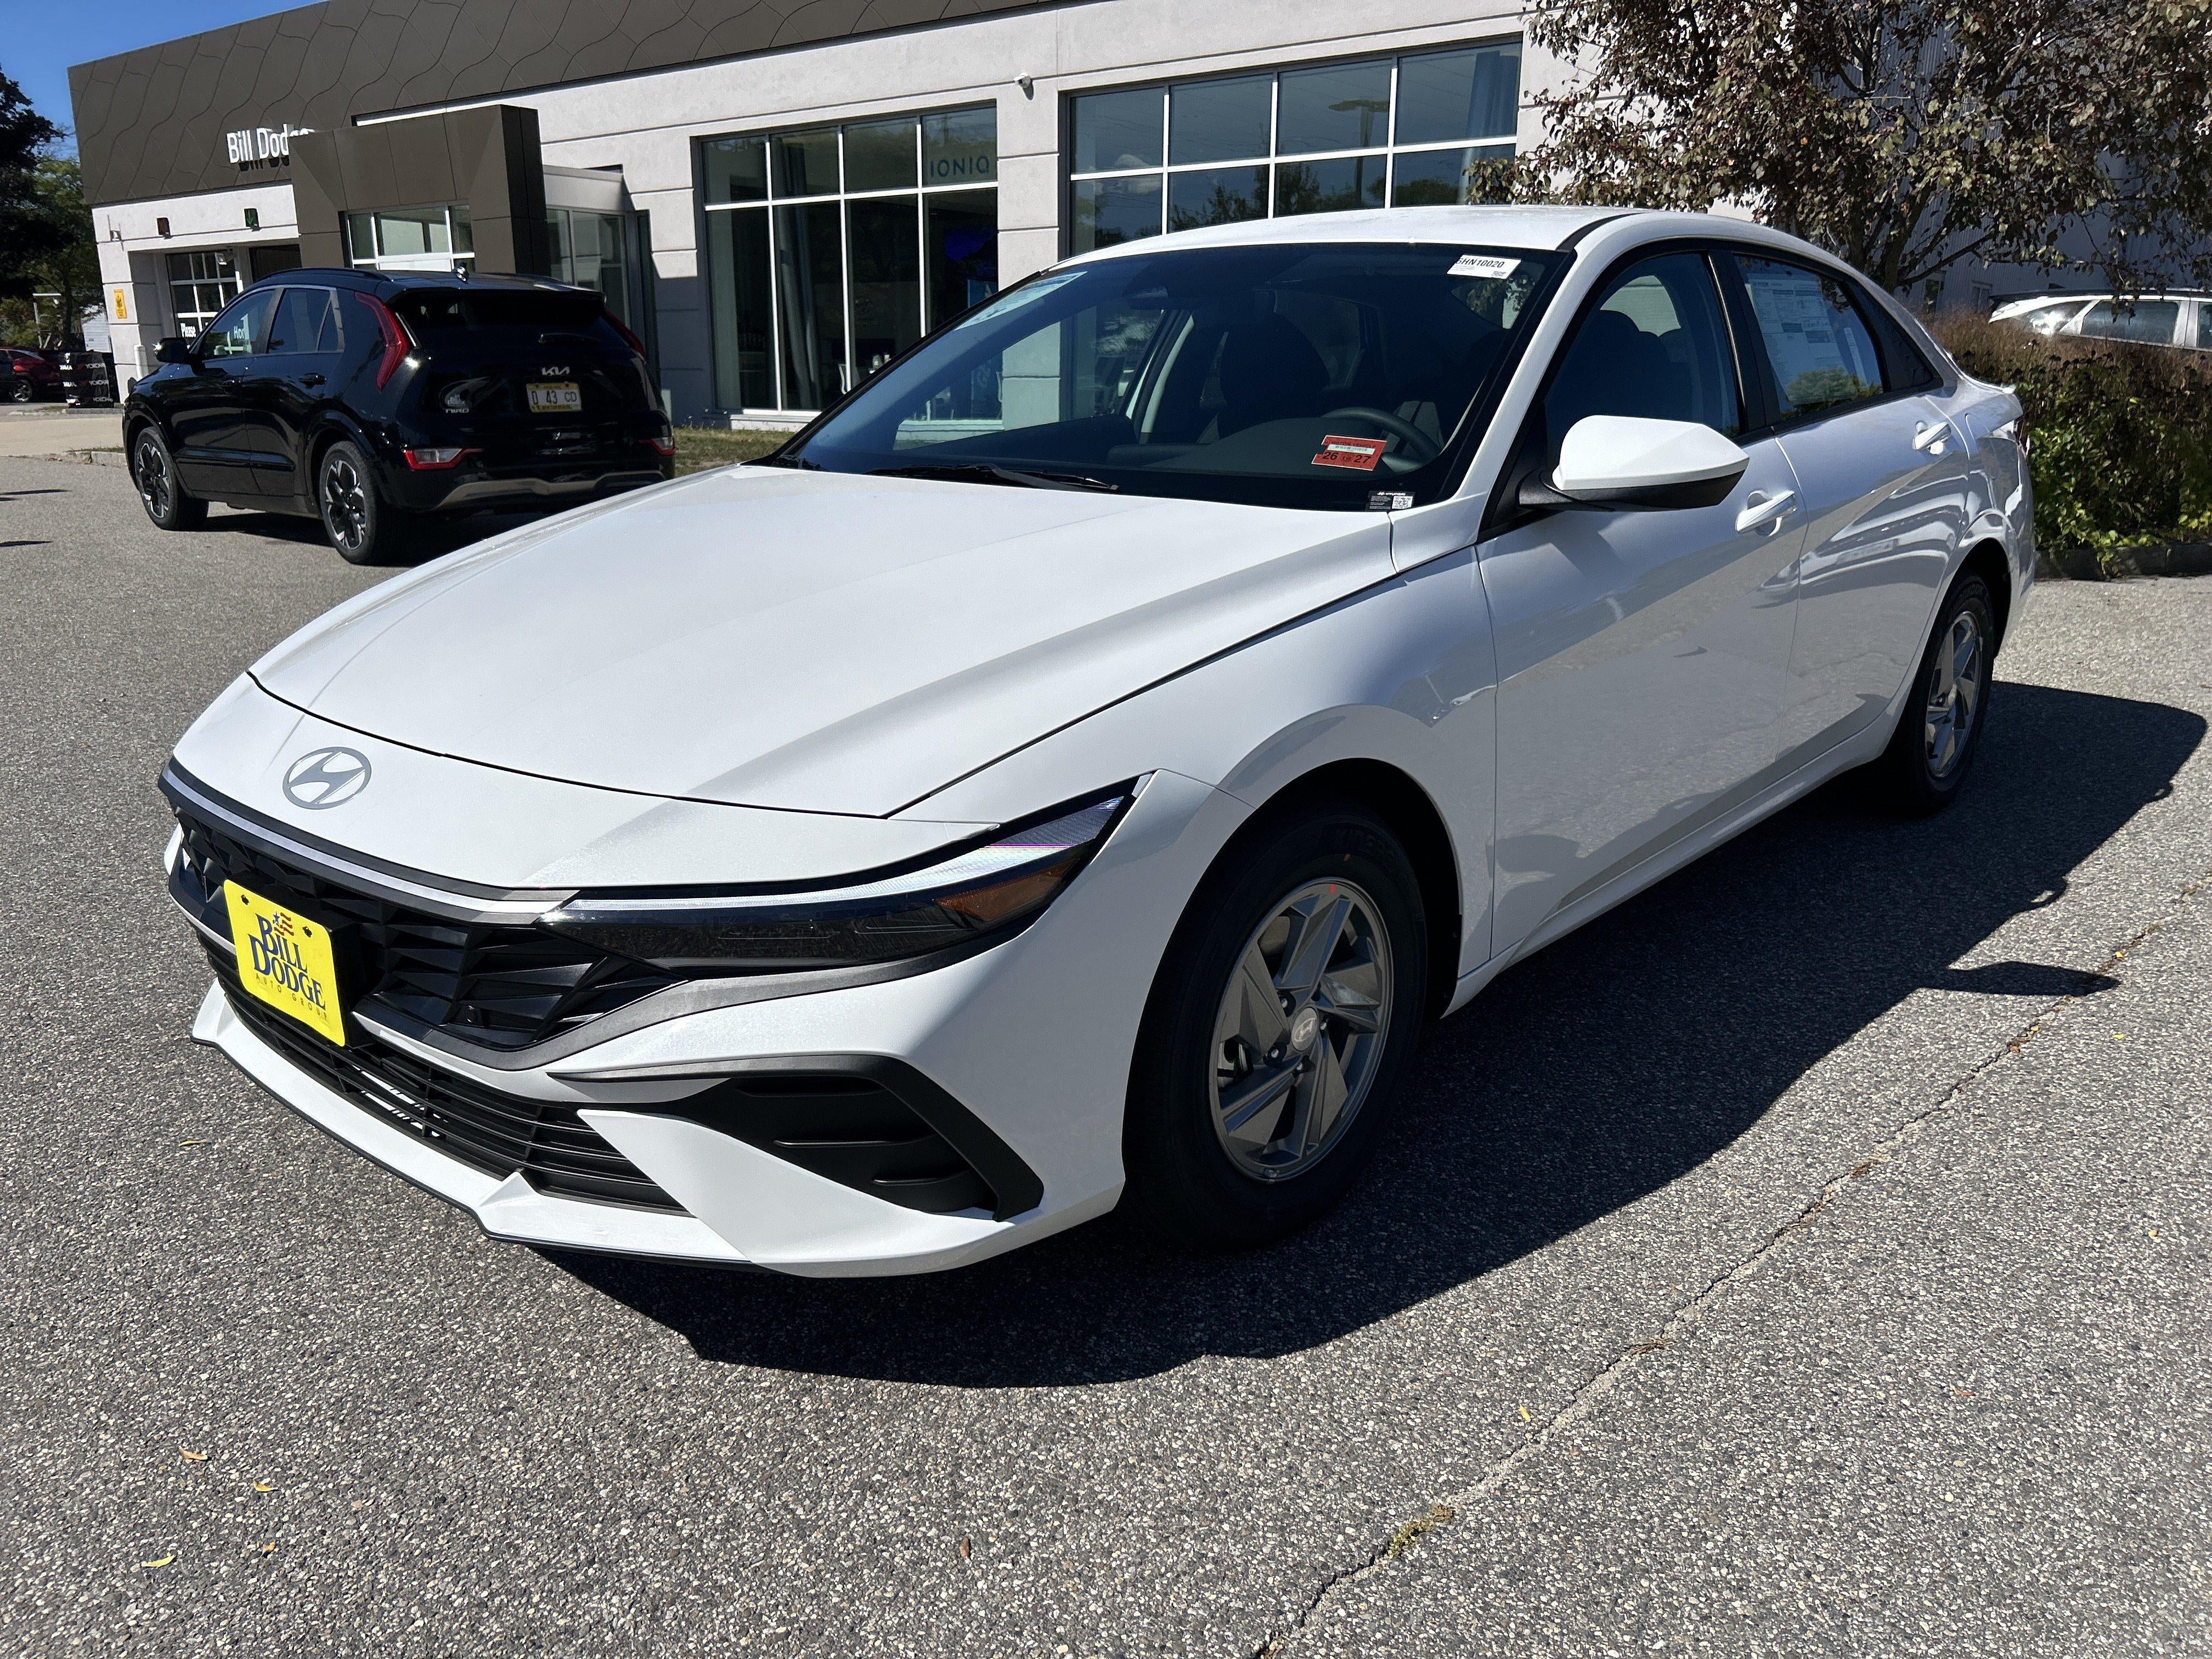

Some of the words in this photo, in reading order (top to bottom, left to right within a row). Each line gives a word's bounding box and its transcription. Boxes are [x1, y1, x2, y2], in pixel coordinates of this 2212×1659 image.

[227, 130, 253, 163] Bill
[256, 123, 315, 159] Dod
[930, 155, 989, 178] IONIQ
[546, 390, 557, 404] 43
[1322, 452, 1338, 460] 26
[1353, 455, 1372, 464] 27
[255, 913, 307, 972] BILL
[248, 934, 325, 1010] DODGE
[256, 973, 282, 993] AUTO
[292, 993, 327, 1019] GROUP
